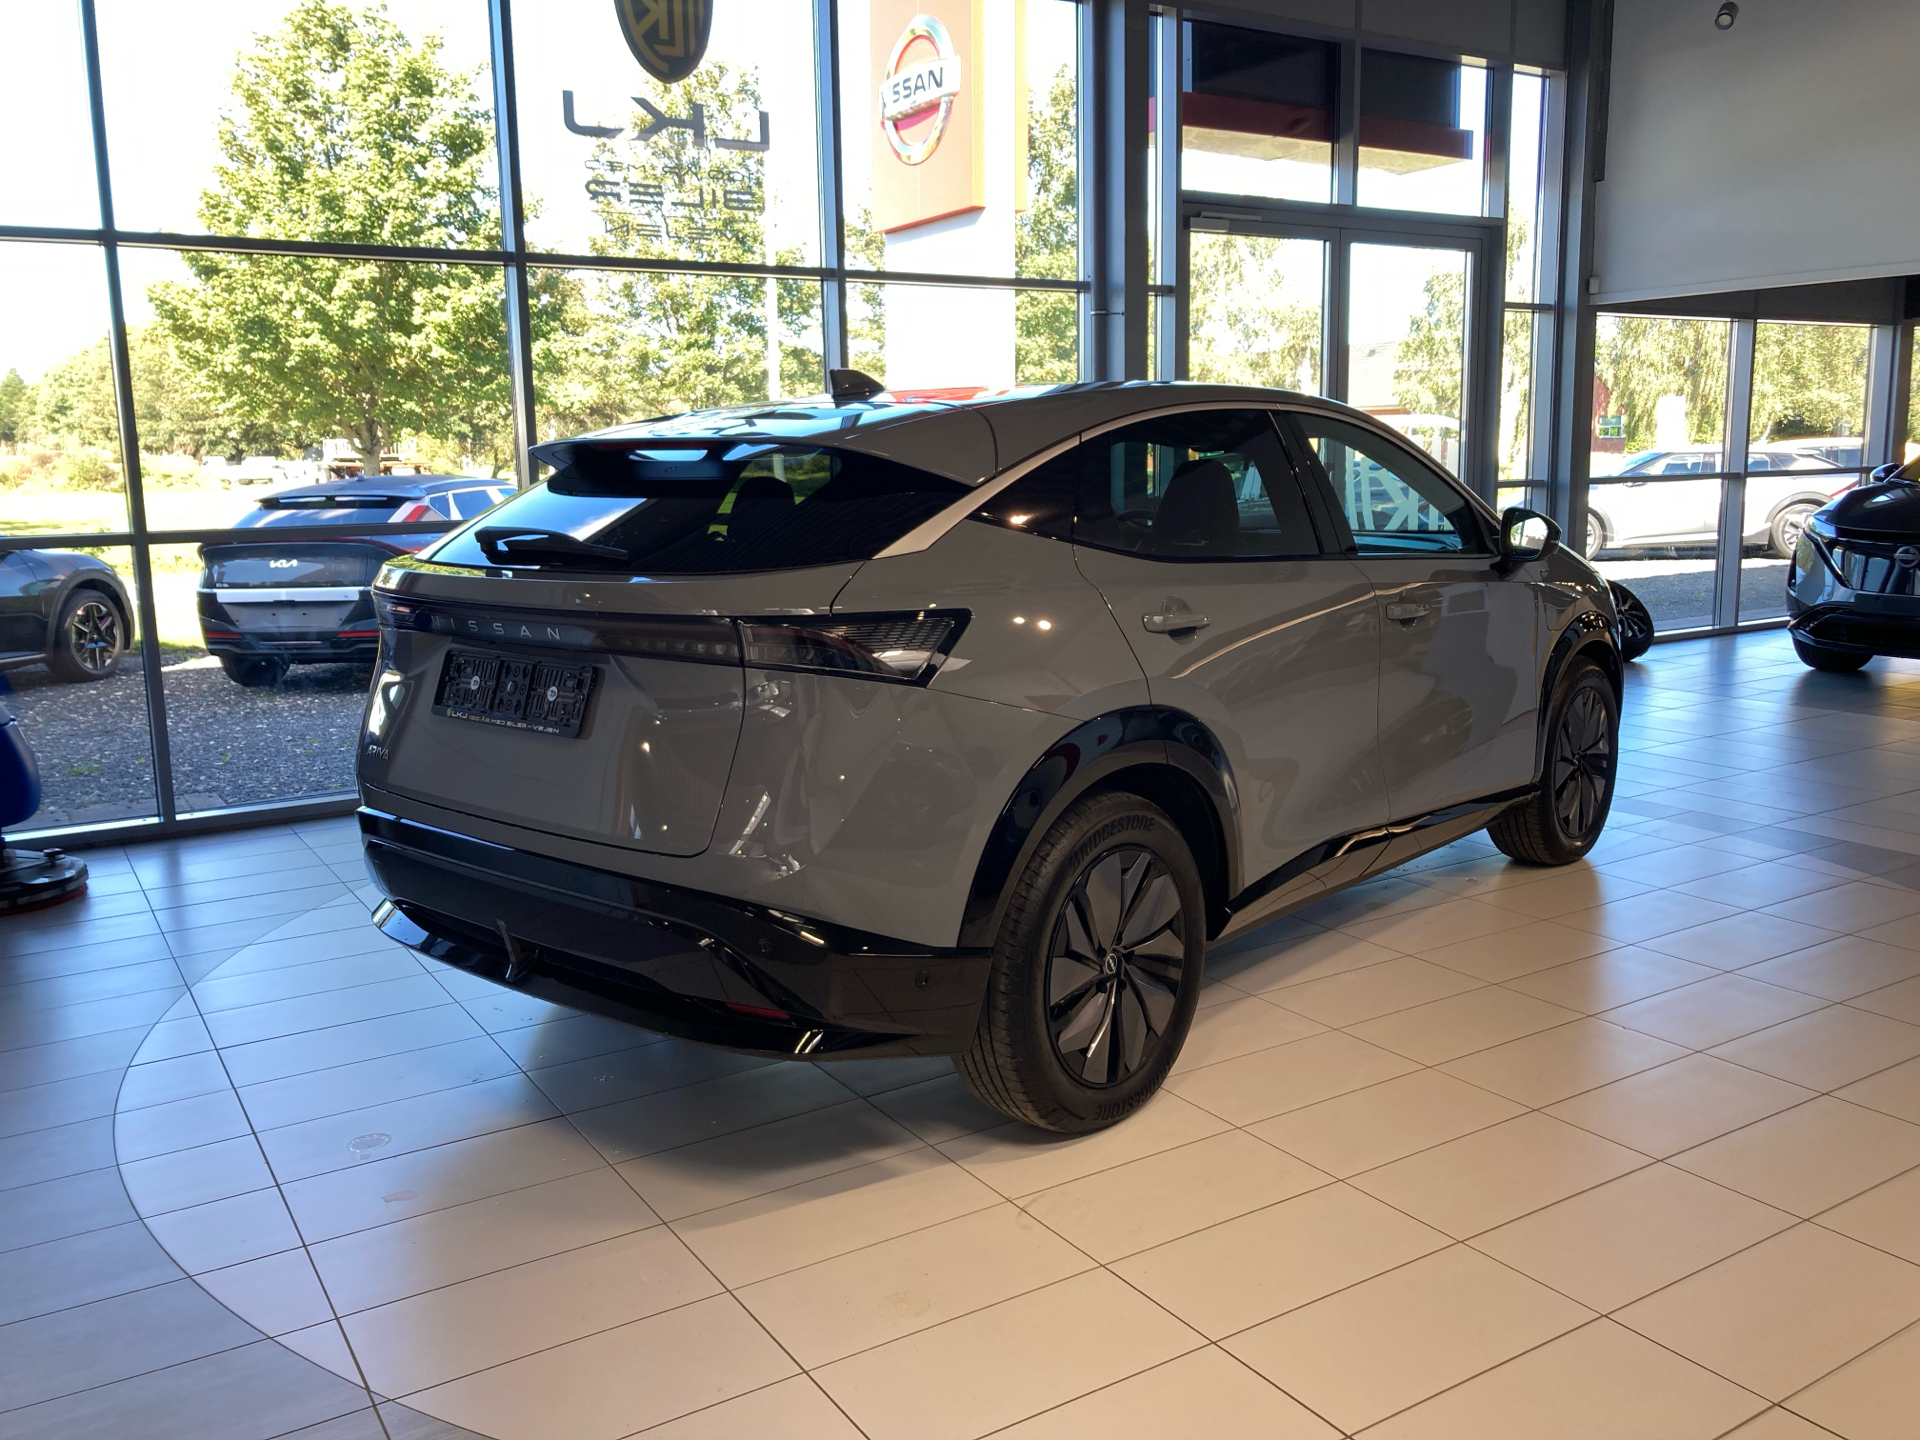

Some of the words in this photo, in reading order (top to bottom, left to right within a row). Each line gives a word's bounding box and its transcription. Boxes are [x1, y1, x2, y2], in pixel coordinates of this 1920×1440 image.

[880, 66, 944, 108] NSSAN
[269, 559, 298, 569] KIA
[430, 615, 561, 640] NISSAN
[451, 710, 468, 719] LKJ
[490, 718, 506, 726] MED
[506, 720, 527, 729] BILER
[532, 725, 560, 734] VEJEN
[365, 744, 390, 762] ARIYA
[1067, 814, 1156, 873] BRIDGESTONE
